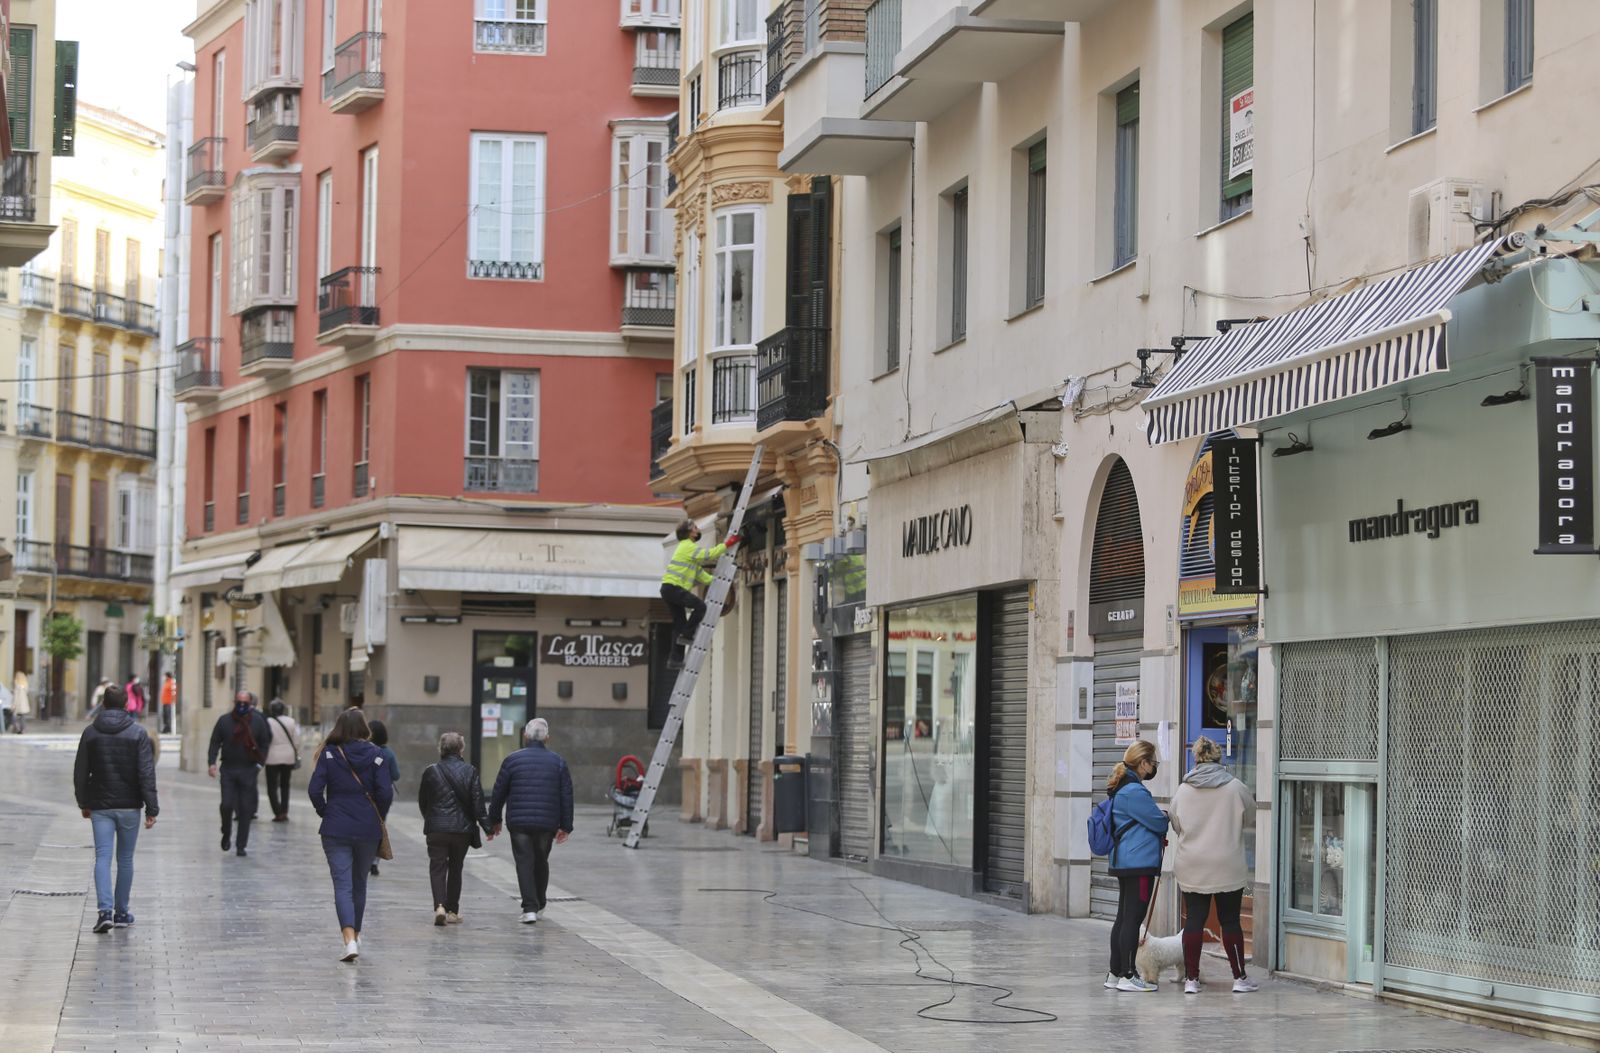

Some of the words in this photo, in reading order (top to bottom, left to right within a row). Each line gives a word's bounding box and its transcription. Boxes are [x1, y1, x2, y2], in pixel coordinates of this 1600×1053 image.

[1228, 447, 1241, 519] interior
[1551, 367, 1576, 545] mandragora
[902, 513, 940, 558] MATILDE
[940, 503, 973, 549] CANO
[1348, 498, 1480, 543] mandragora
[1230, 529, 1243, 587] design
[547, 635, 577, 656] La
[580, 634, 645, 657] Tasca
[564, 655, 630, 667] BOOMBEER
